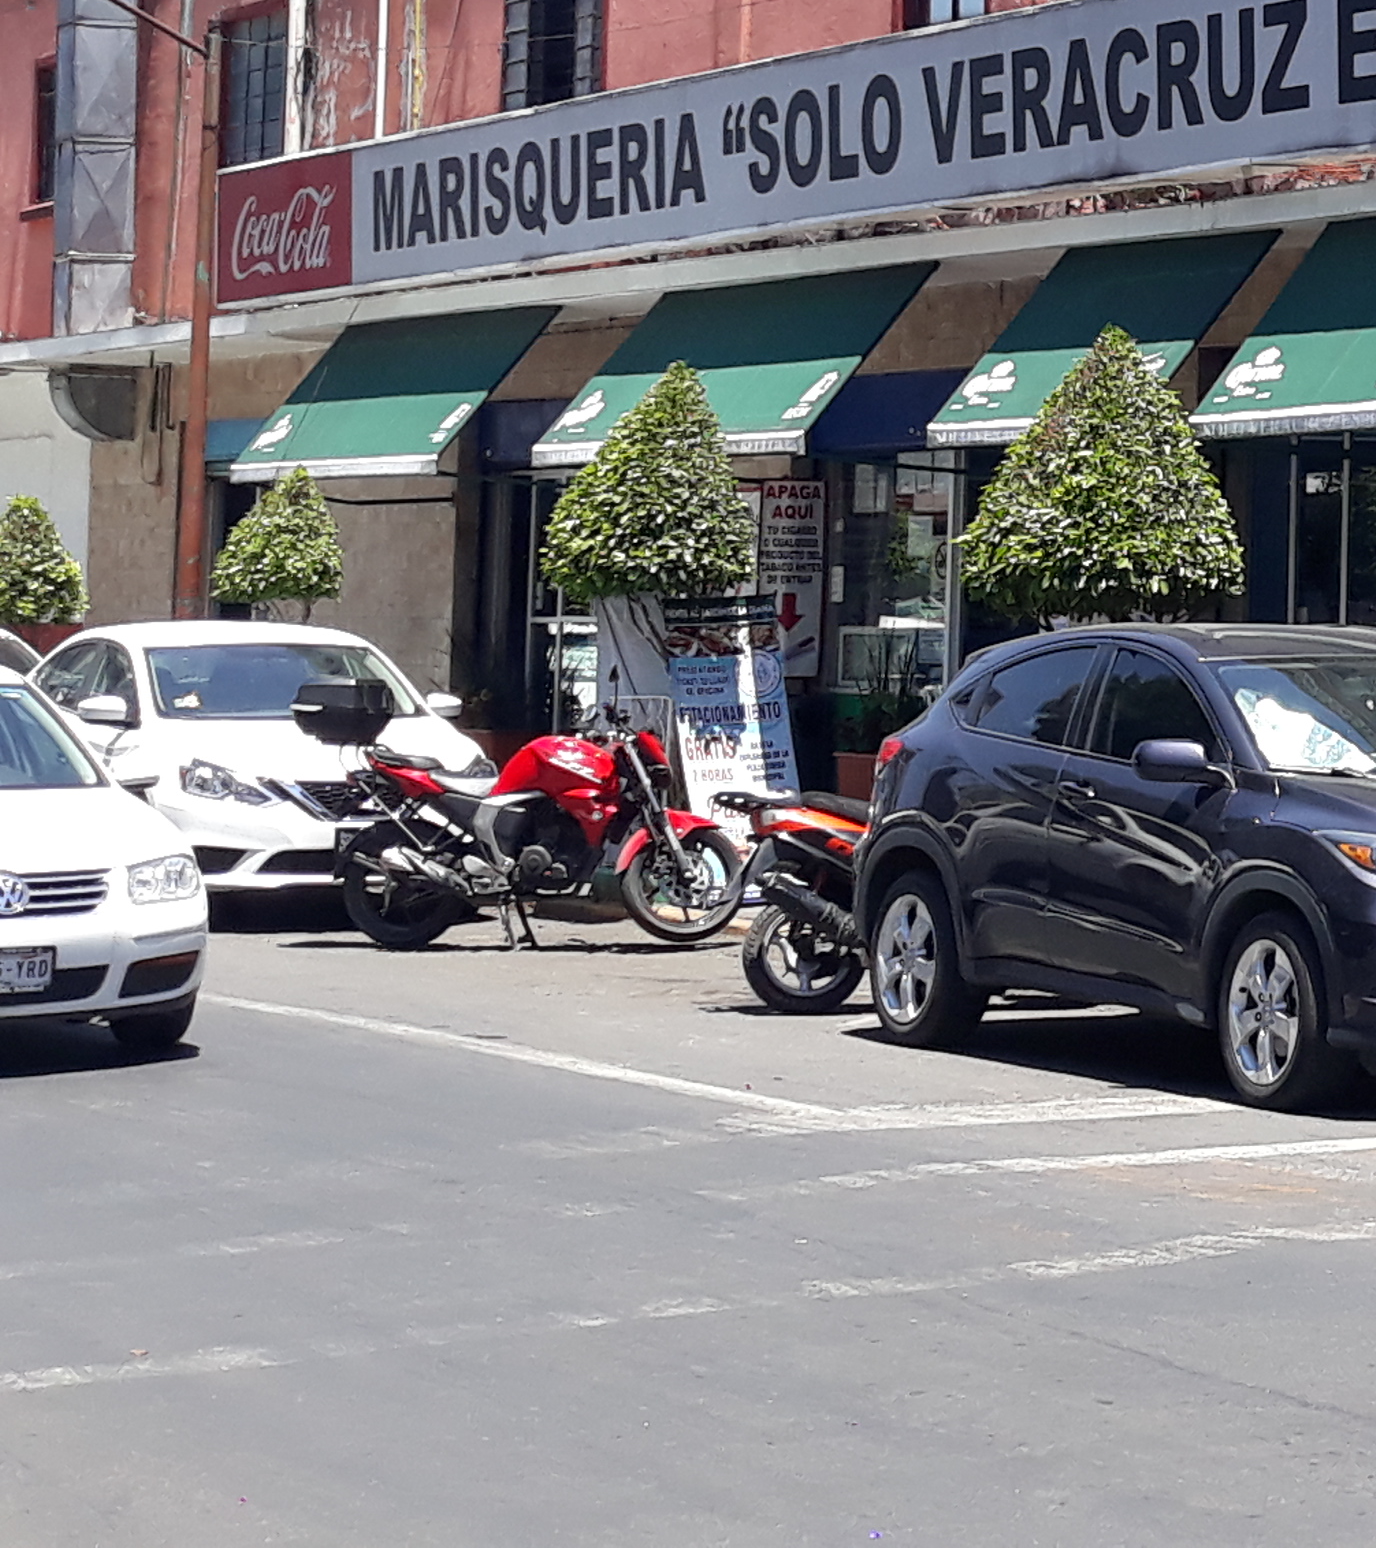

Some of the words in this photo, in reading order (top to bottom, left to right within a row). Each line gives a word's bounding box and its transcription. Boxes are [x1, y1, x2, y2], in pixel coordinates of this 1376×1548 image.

[372, 112, 706, 253] MARISQUERIA
[722, 73, 902, 195] “SOLO
[231, 183, 337, 280] Coca-Cola
[765, 484, 822, 500] APAGA
[685, 736, 738, 761] GRATIS
